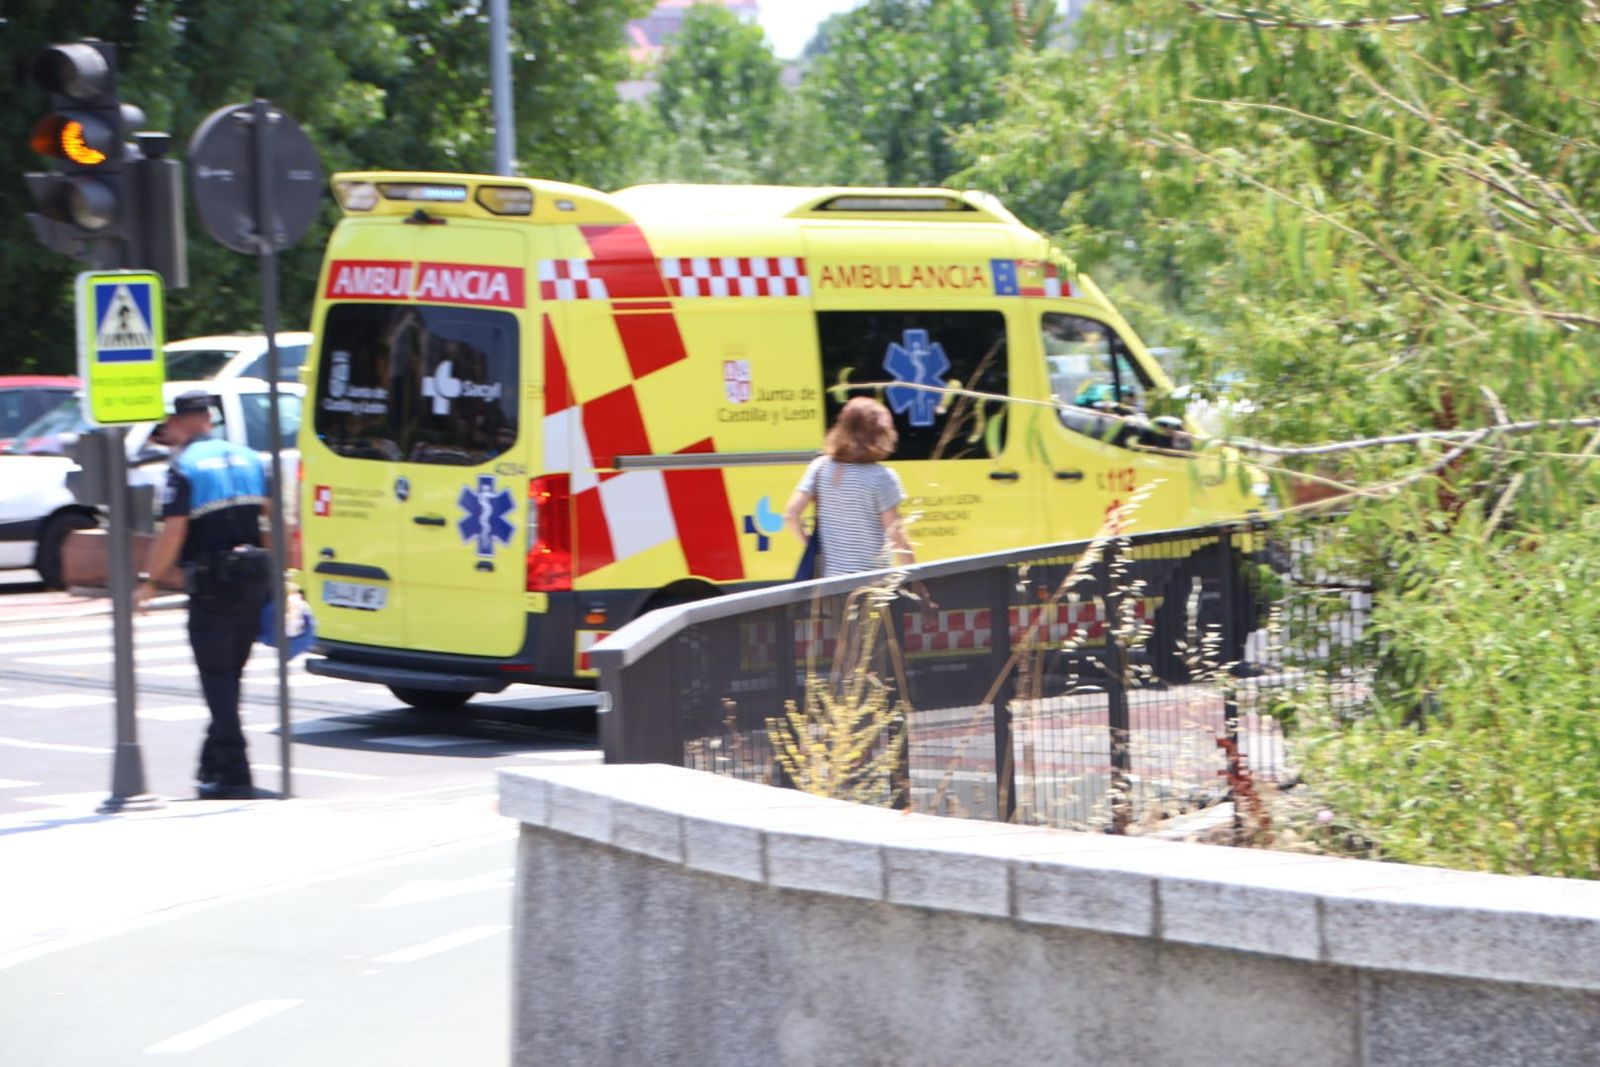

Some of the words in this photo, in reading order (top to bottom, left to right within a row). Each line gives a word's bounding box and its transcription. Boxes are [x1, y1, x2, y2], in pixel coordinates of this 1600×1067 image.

[332, 265, 510, 302] AMBULANCIA
[818, 264, 987, 289] AMBULANCIA
[756, 387, 796, 402] Junta
[800, 387, 816, 401] de
[717, 407, 768, 423] Castilla
[770, 409, 780, 426] y
[1107, 467, 1135, 492] 112
